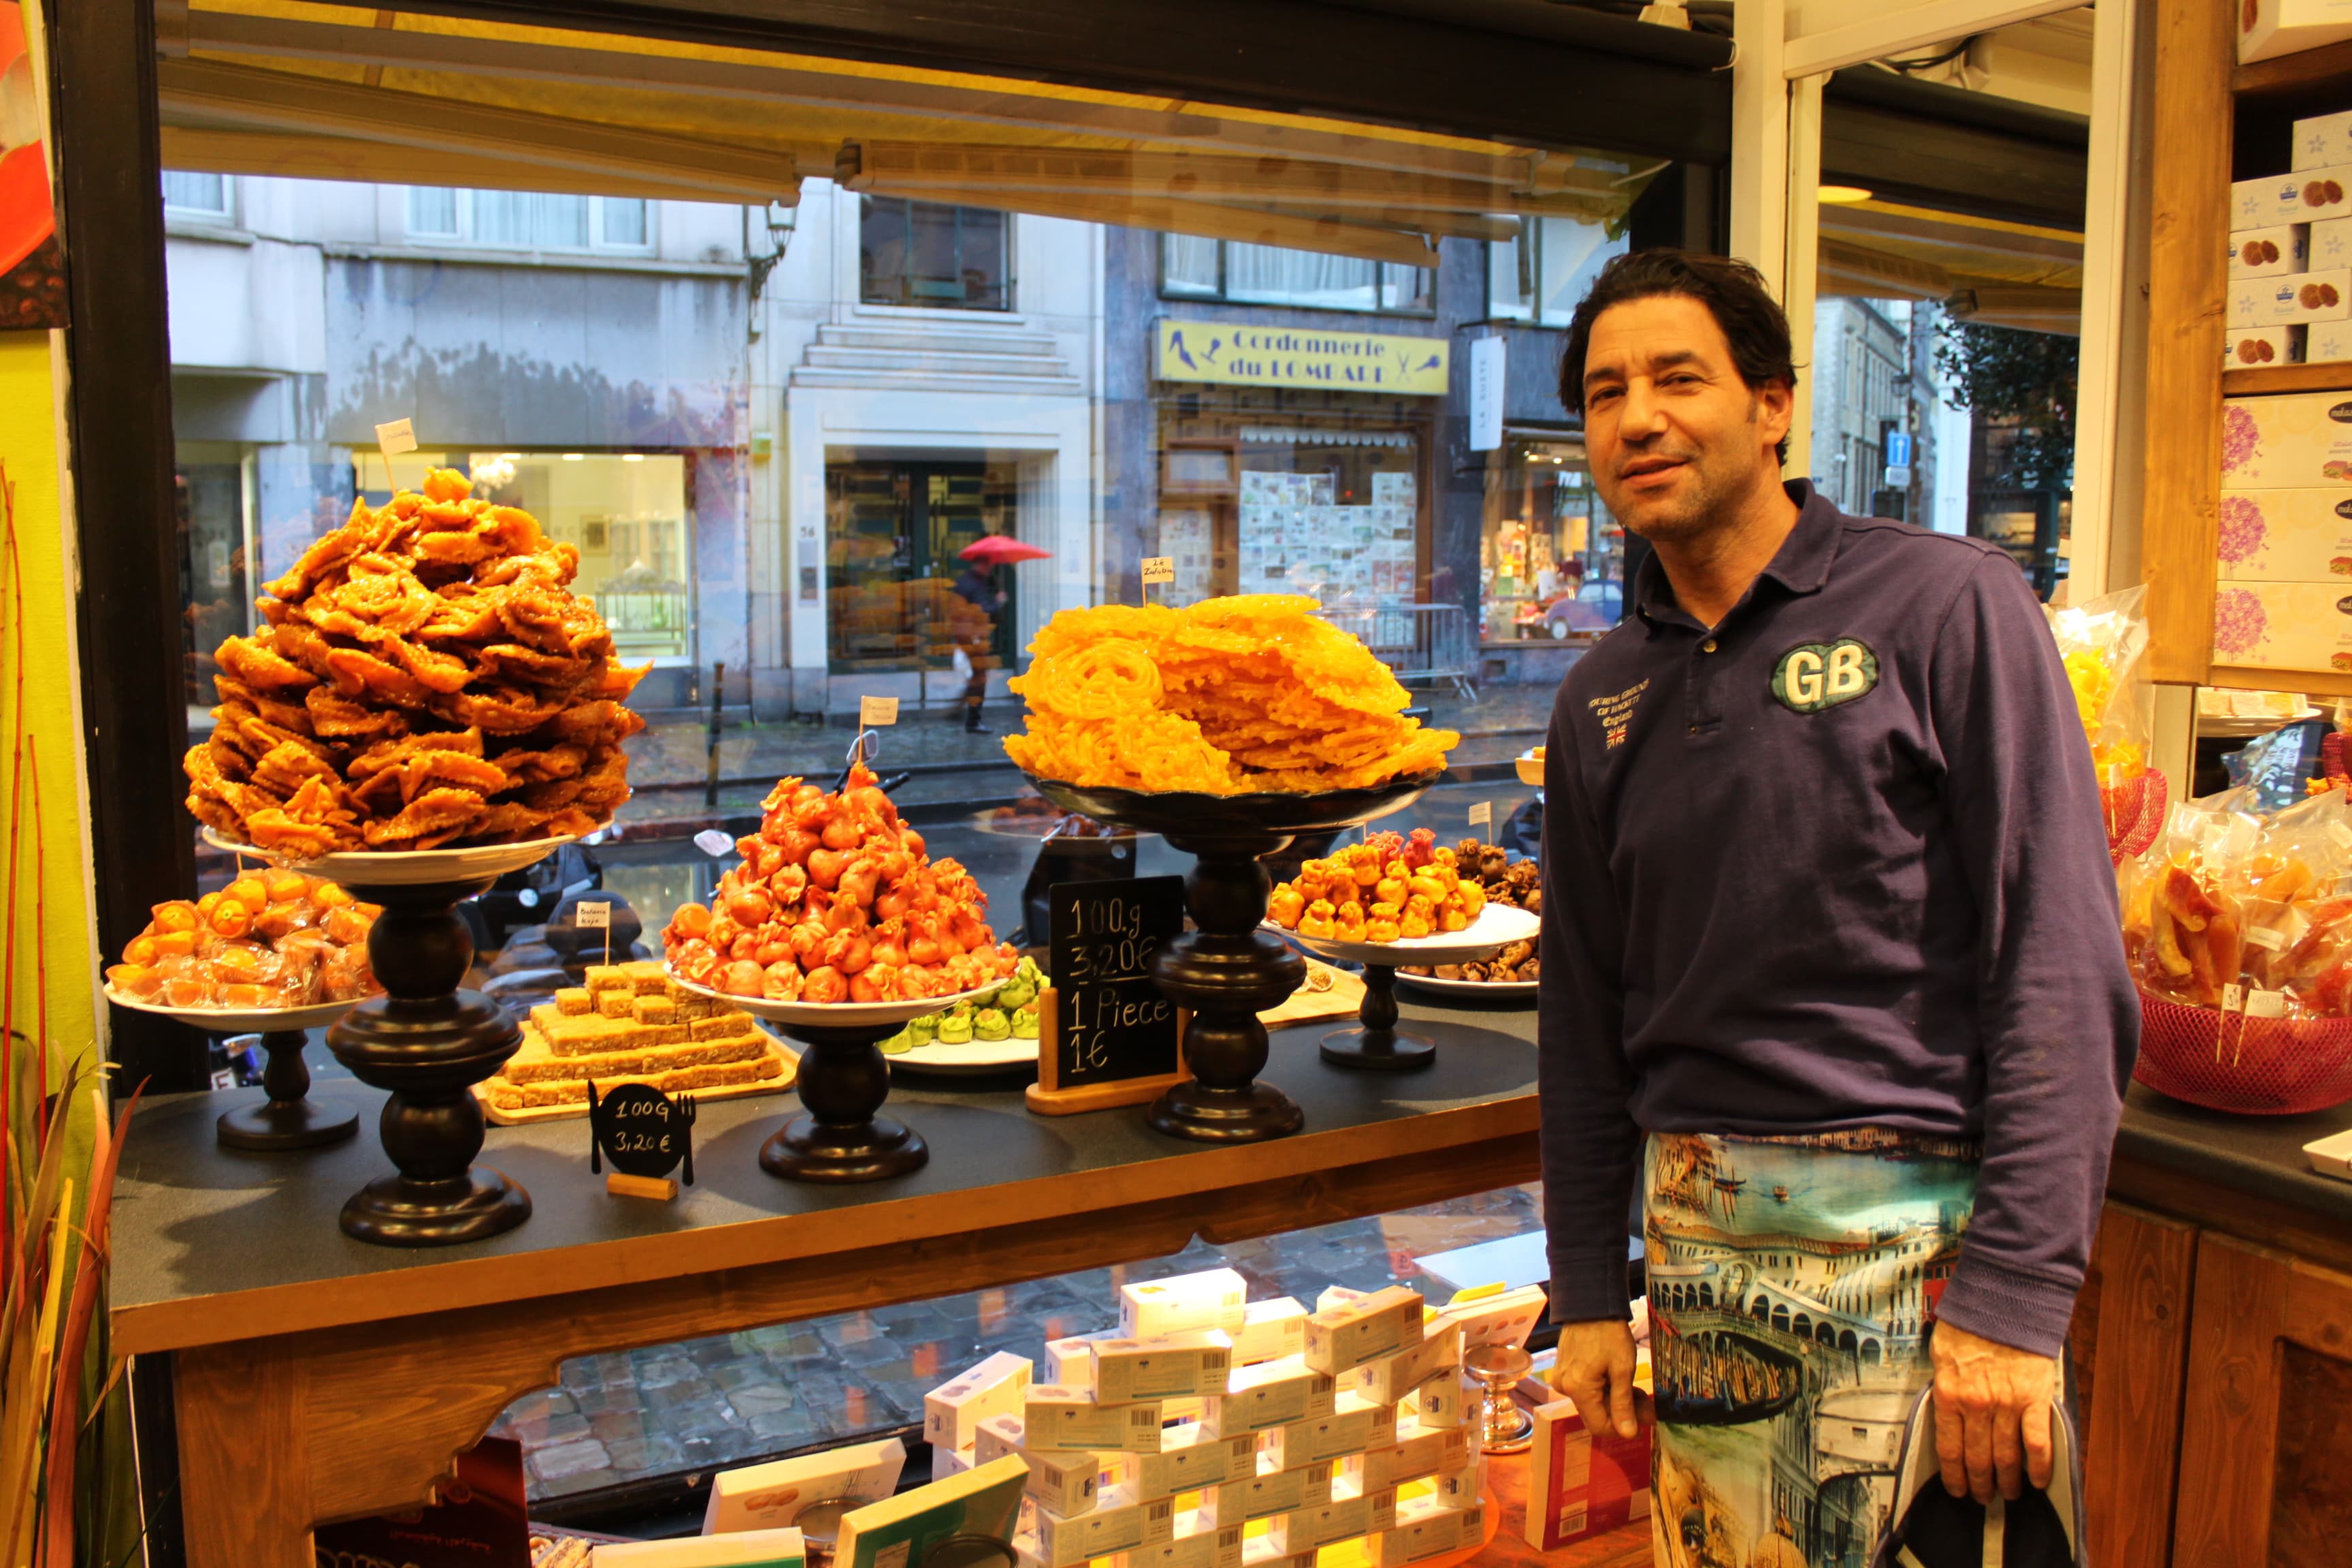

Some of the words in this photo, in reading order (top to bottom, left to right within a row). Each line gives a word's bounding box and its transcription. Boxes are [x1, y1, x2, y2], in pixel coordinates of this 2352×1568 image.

[1232, 330, 1386, 358] Cordonnerie
[1229, 357, 1262, 376] du
[1271, 360, 1390, 384] LOMBARD
[1785, 644, 1865, 705] GB
[1069, 1030, 1109, 1073] 1€
[615, 1100, 670, 1123] 100G
